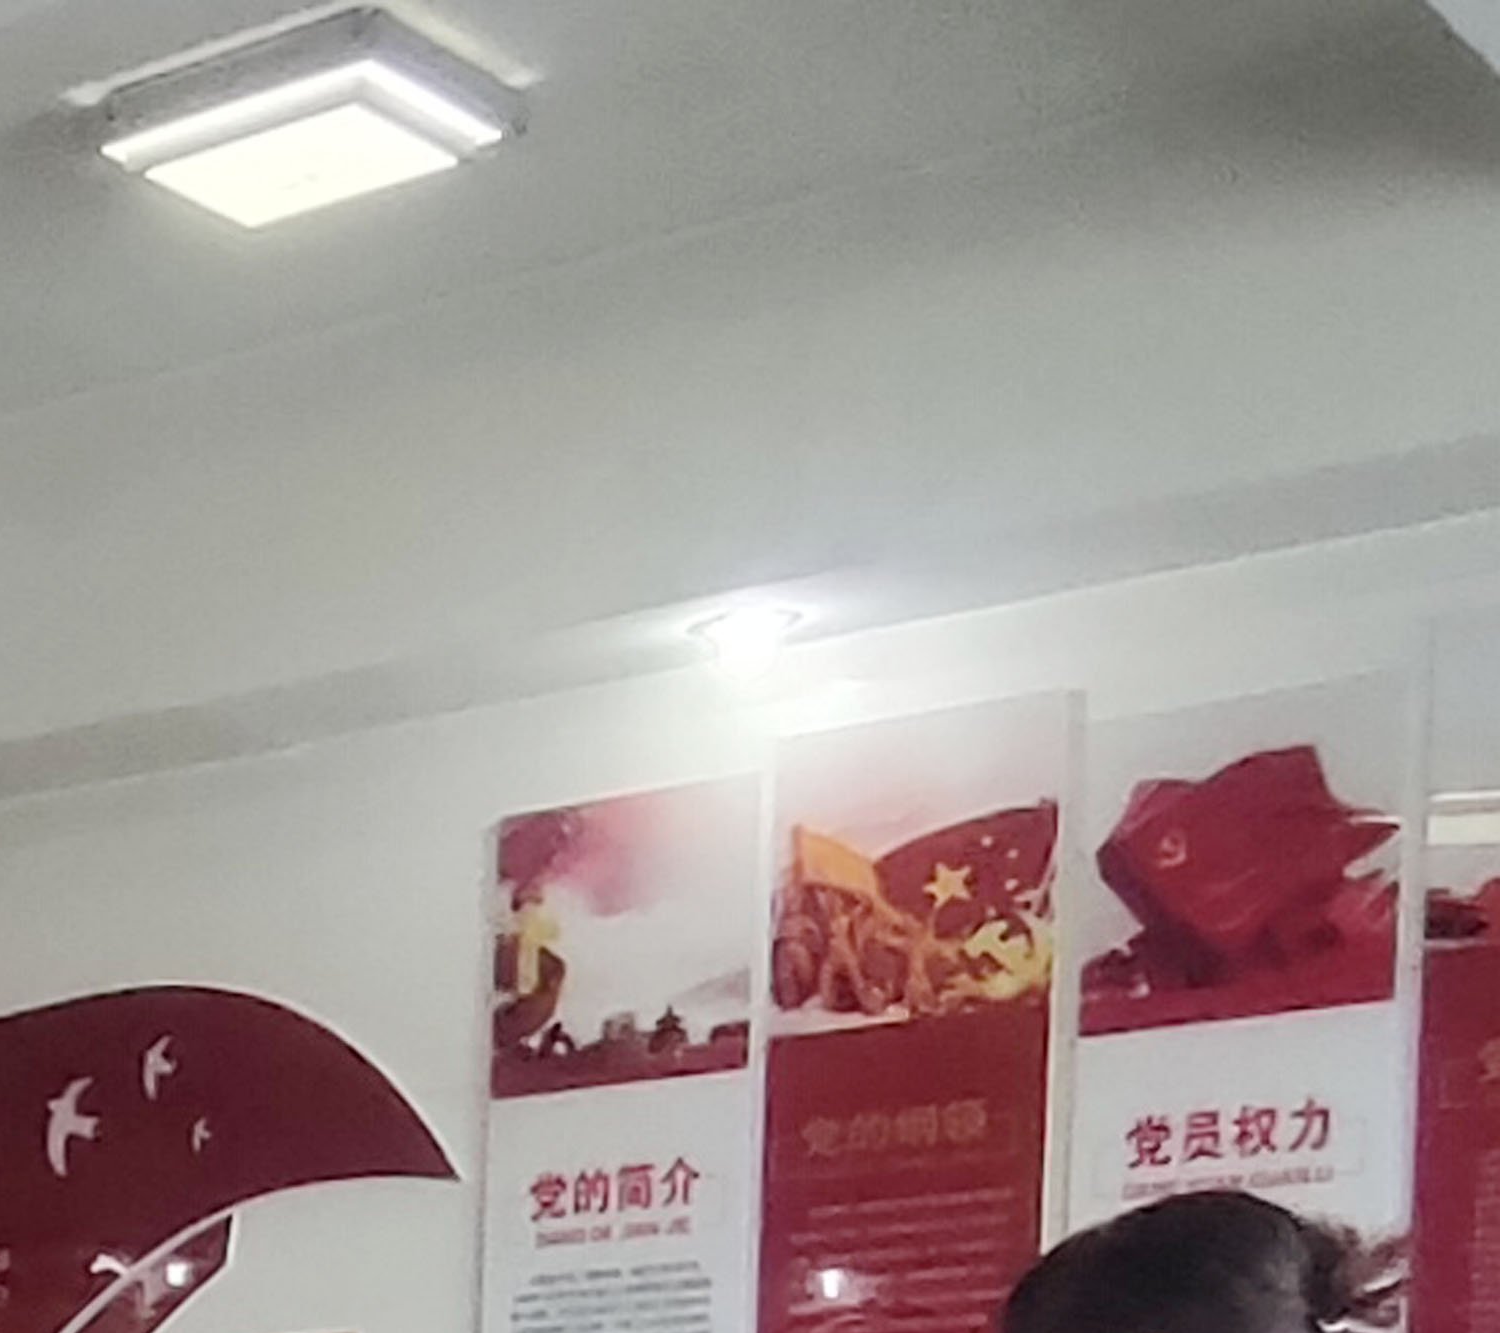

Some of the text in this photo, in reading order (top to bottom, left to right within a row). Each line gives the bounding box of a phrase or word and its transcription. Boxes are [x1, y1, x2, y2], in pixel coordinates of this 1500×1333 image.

[1125, 1098, 1332, 1170] 党员权力
[529, 1156, 700, 1223] 党的简介
